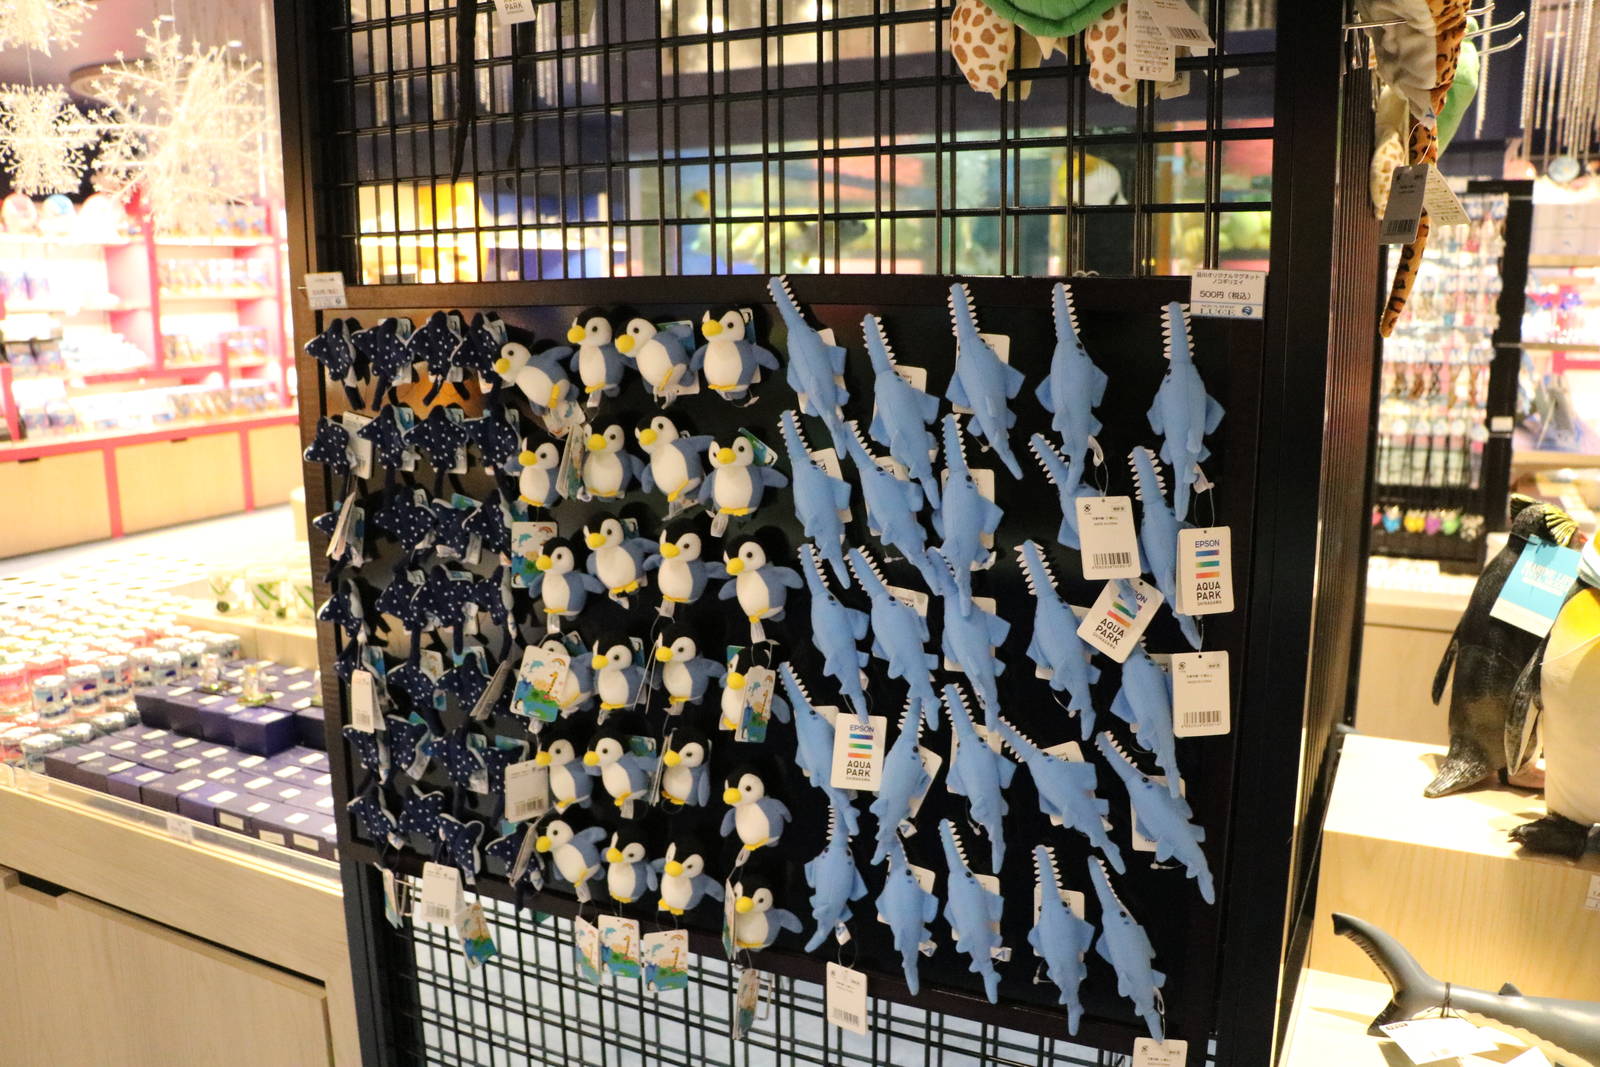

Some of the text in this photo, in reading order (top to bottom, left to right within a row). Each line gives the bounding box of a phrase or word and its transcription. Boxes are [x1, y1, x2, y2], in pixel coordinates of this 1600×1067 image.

[1195, 540, 1220, 548] EPSON
[1196, 581, 1221, 591] AQUA
[1196, 591, 1222, 600] PARK
[1100, 618, 1125, 638] AQUA
[1095, 625, 1121, 646] PARK
[849, 724, 874, 732] EPSON
[847, 760, 871, 769] AQUA
[846, 768, 871, 777] PARK
